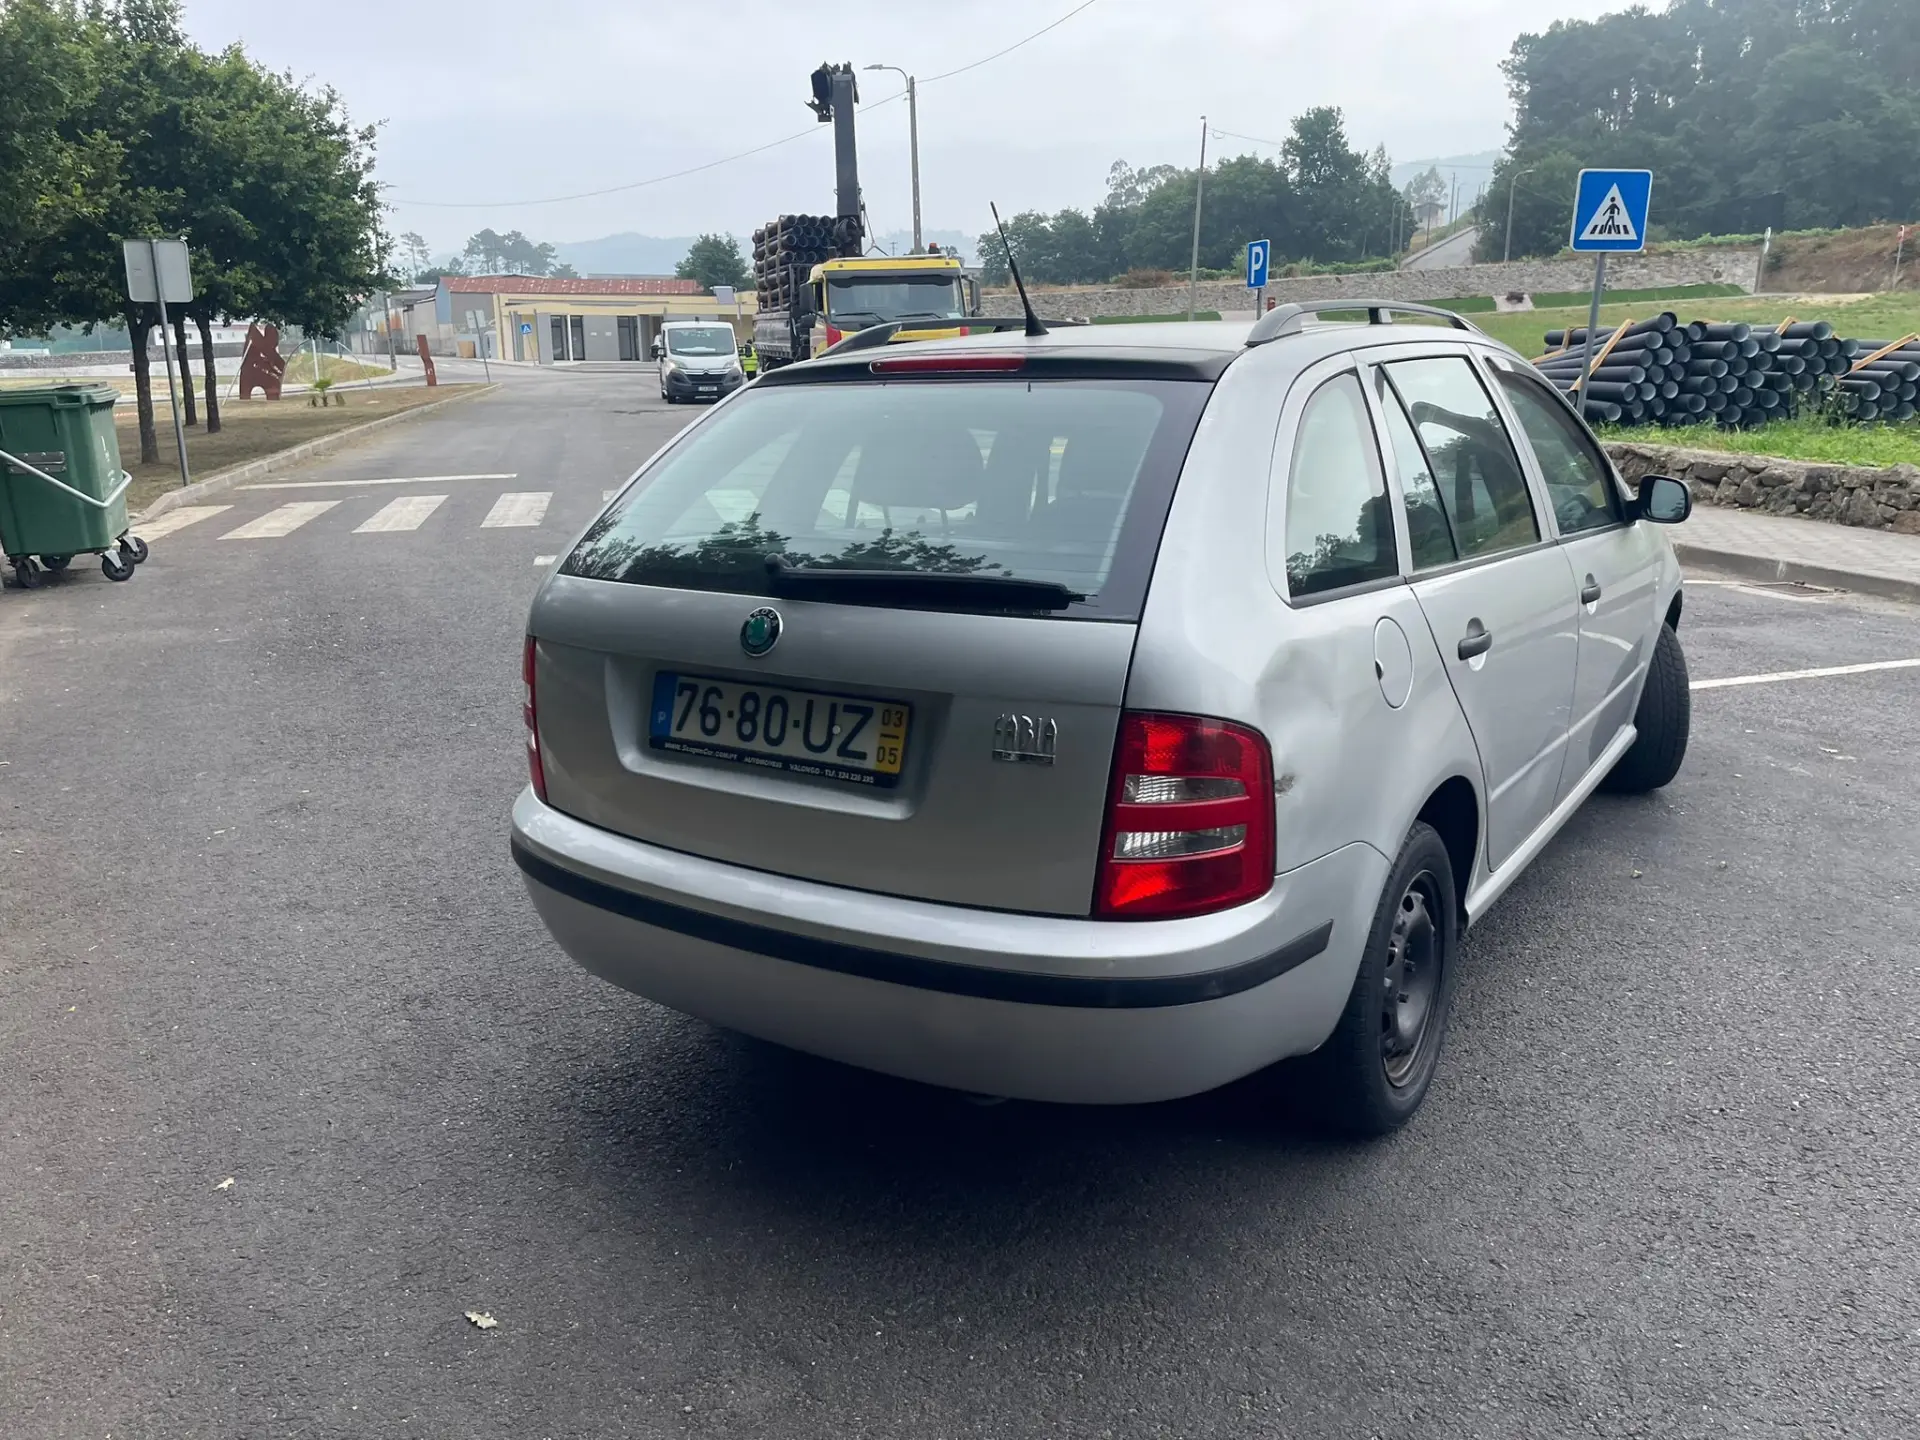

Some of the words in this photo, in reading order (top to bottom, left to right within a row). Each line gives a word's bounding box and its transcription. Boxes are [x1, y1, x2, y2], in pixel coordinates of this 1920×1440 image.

[1250, 245, 1264, 285] P
[657, 711, 667, 724] P
[881, 708, 904, 728] 03
[876, 745, 899, 765] 05
